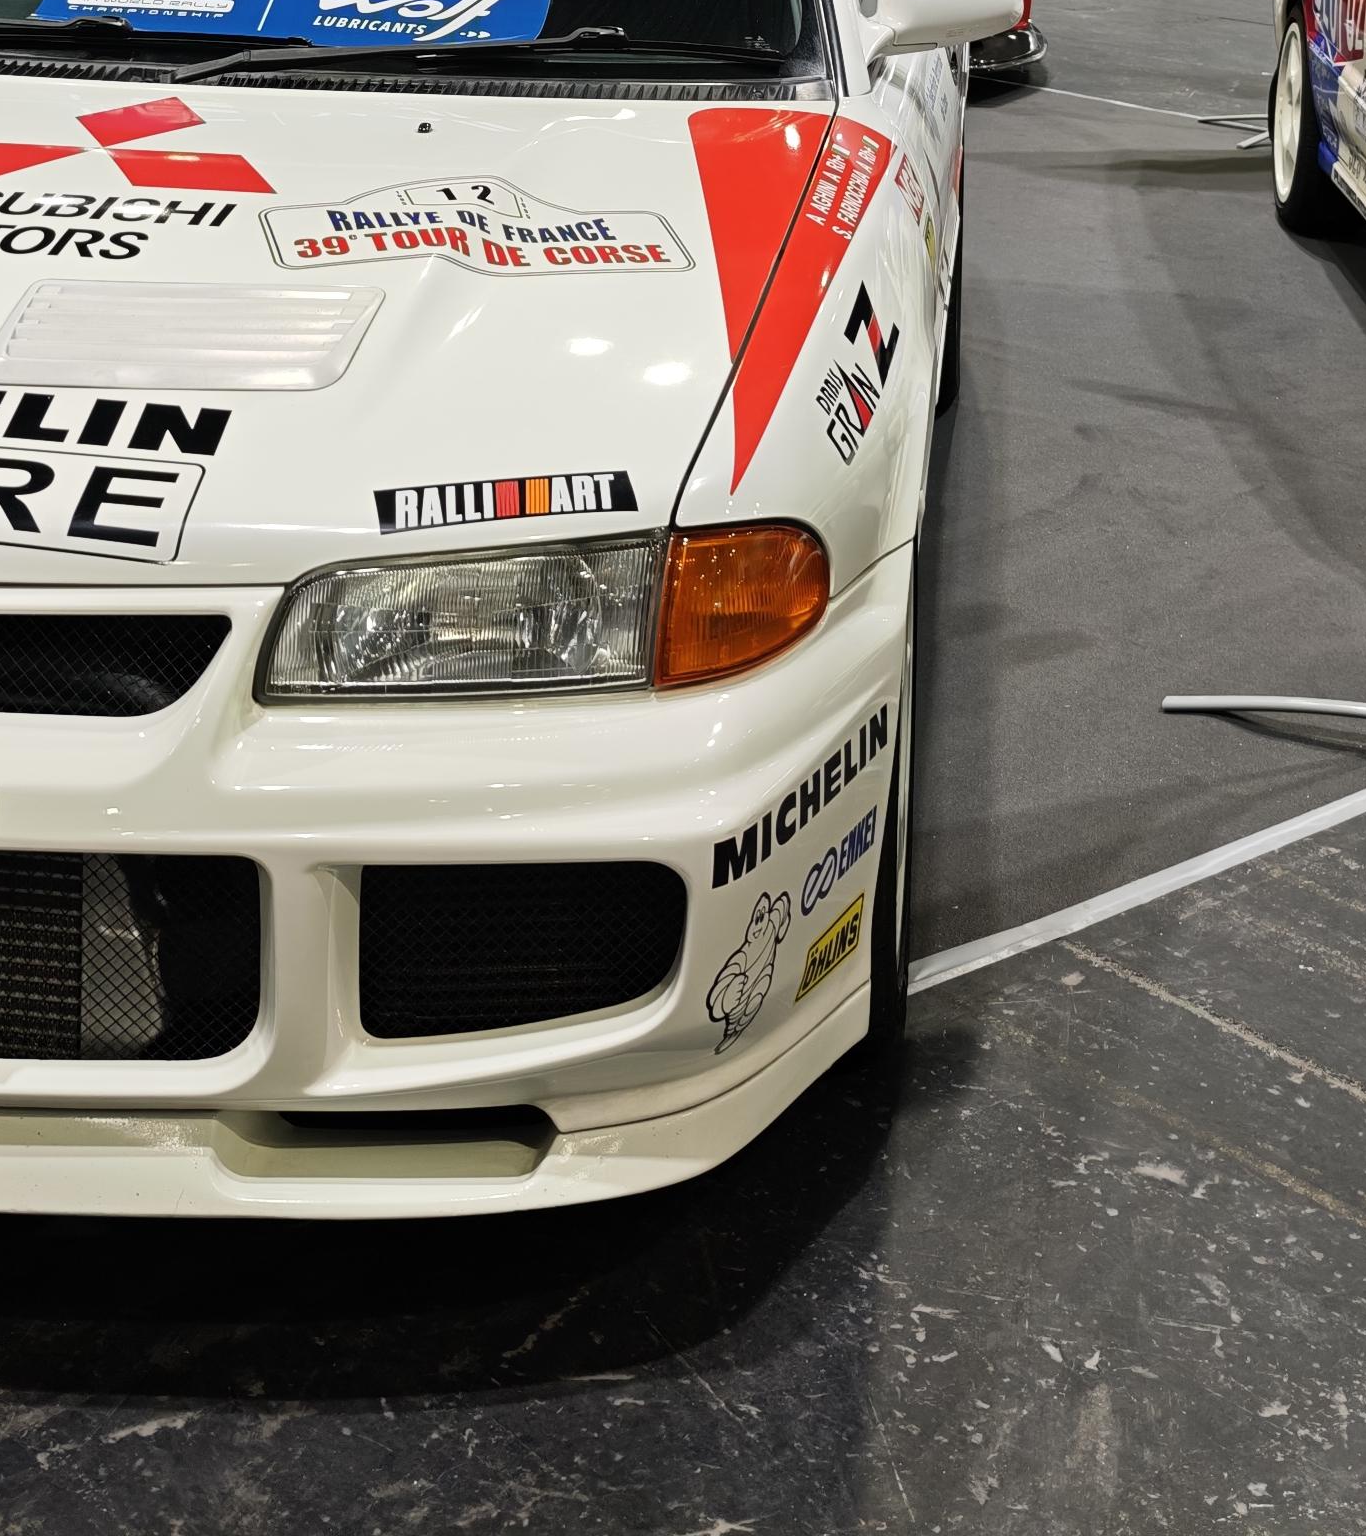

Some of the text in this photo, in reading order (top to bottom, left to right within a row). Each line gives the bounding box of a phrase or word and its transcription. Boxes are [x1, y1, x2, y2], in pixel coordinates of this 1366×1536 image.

[312, 16, 429, 37] LUBRICANTS
[325, 209, 618, 244] RALLYE DE FRANCE
[364, 227, 472, 257] TOUR
[480, 237, 532, 268] DE
[544, 244, 672, 265] CORSE
[393, 472, 616, 529] RALLI ART
[711, 702, 889, 890] MICHELIN
[836, 804, 877, 881] ENKEI
